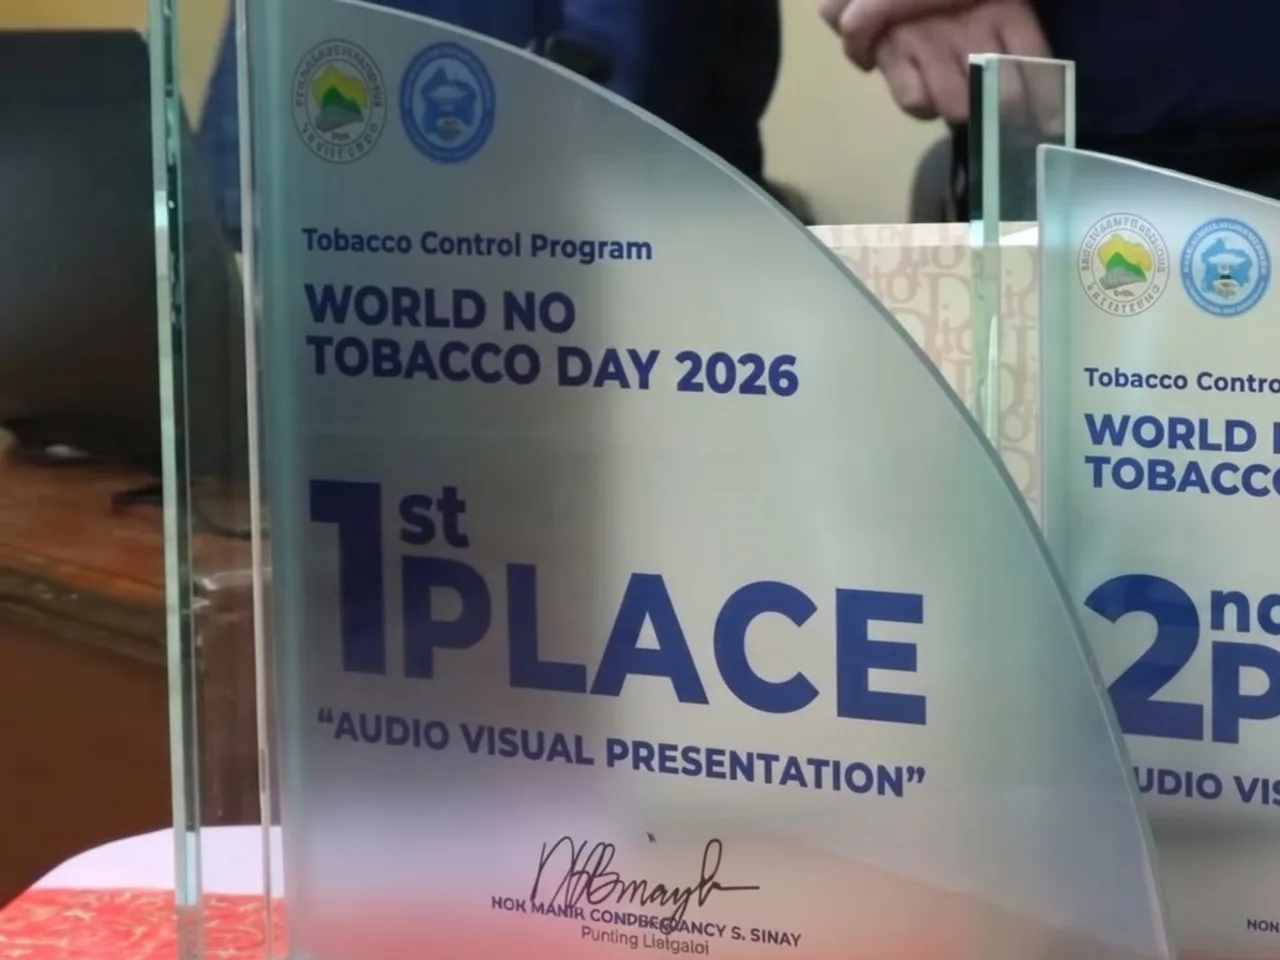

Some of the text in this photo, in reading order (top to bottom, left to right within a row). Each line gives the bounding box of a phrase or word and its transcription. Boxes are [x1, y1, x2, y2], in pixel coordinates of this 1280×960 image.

[302, 228, 653, 263] Tobacco Control Program
[303, 283, 577, 334] WORLD NO
[305, 335, 799, 397] TOBACCO DAY 2026
[1084, 367, 1188, 391] Tobacco
[1084, 413, 1257, 453] WORLD
[400, 554, 927, 726] PLACE
[460, 724, 595, 766] VISUAL
[1132, 766, 1223, 800] UDIO
[750, 928, 802, 947] SINAY
